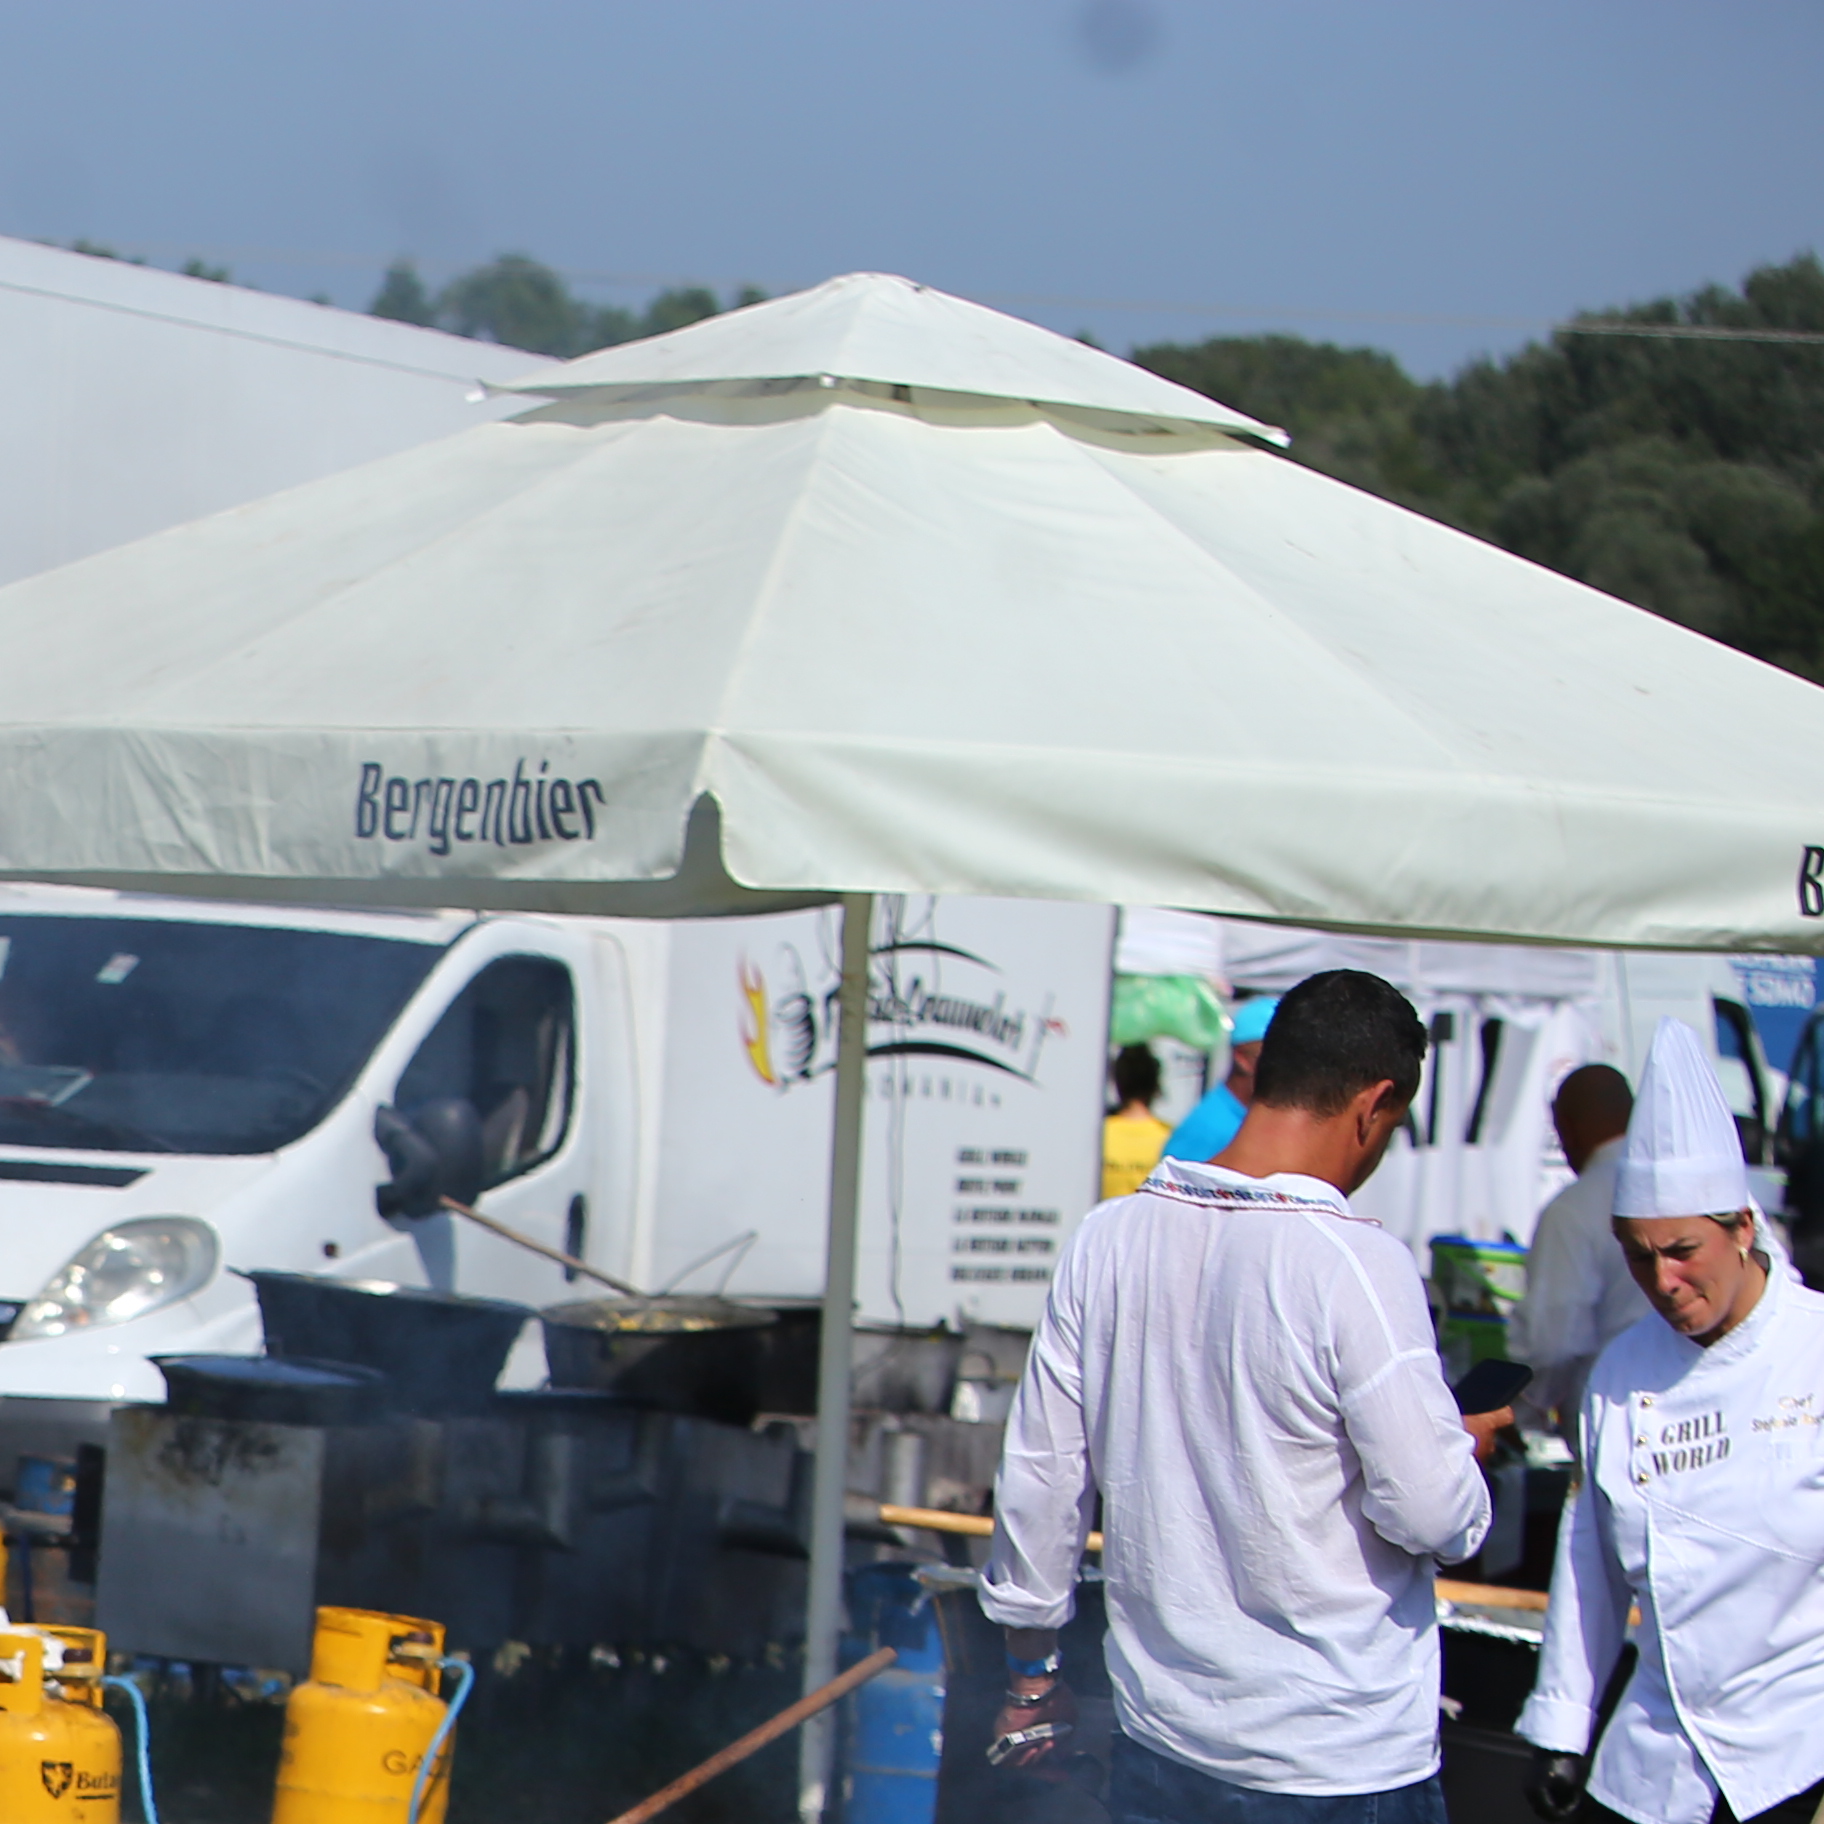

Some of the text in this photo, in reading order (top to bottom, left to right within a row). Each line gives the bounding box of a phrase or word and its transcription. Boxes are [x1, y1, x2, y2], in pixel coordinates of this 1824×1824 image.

[355, 757, 608, 857] Bergenbier
[1661, 1410, 1727, 1445] GRILL
[1652, 1437, 1731, 1476] WORLD
